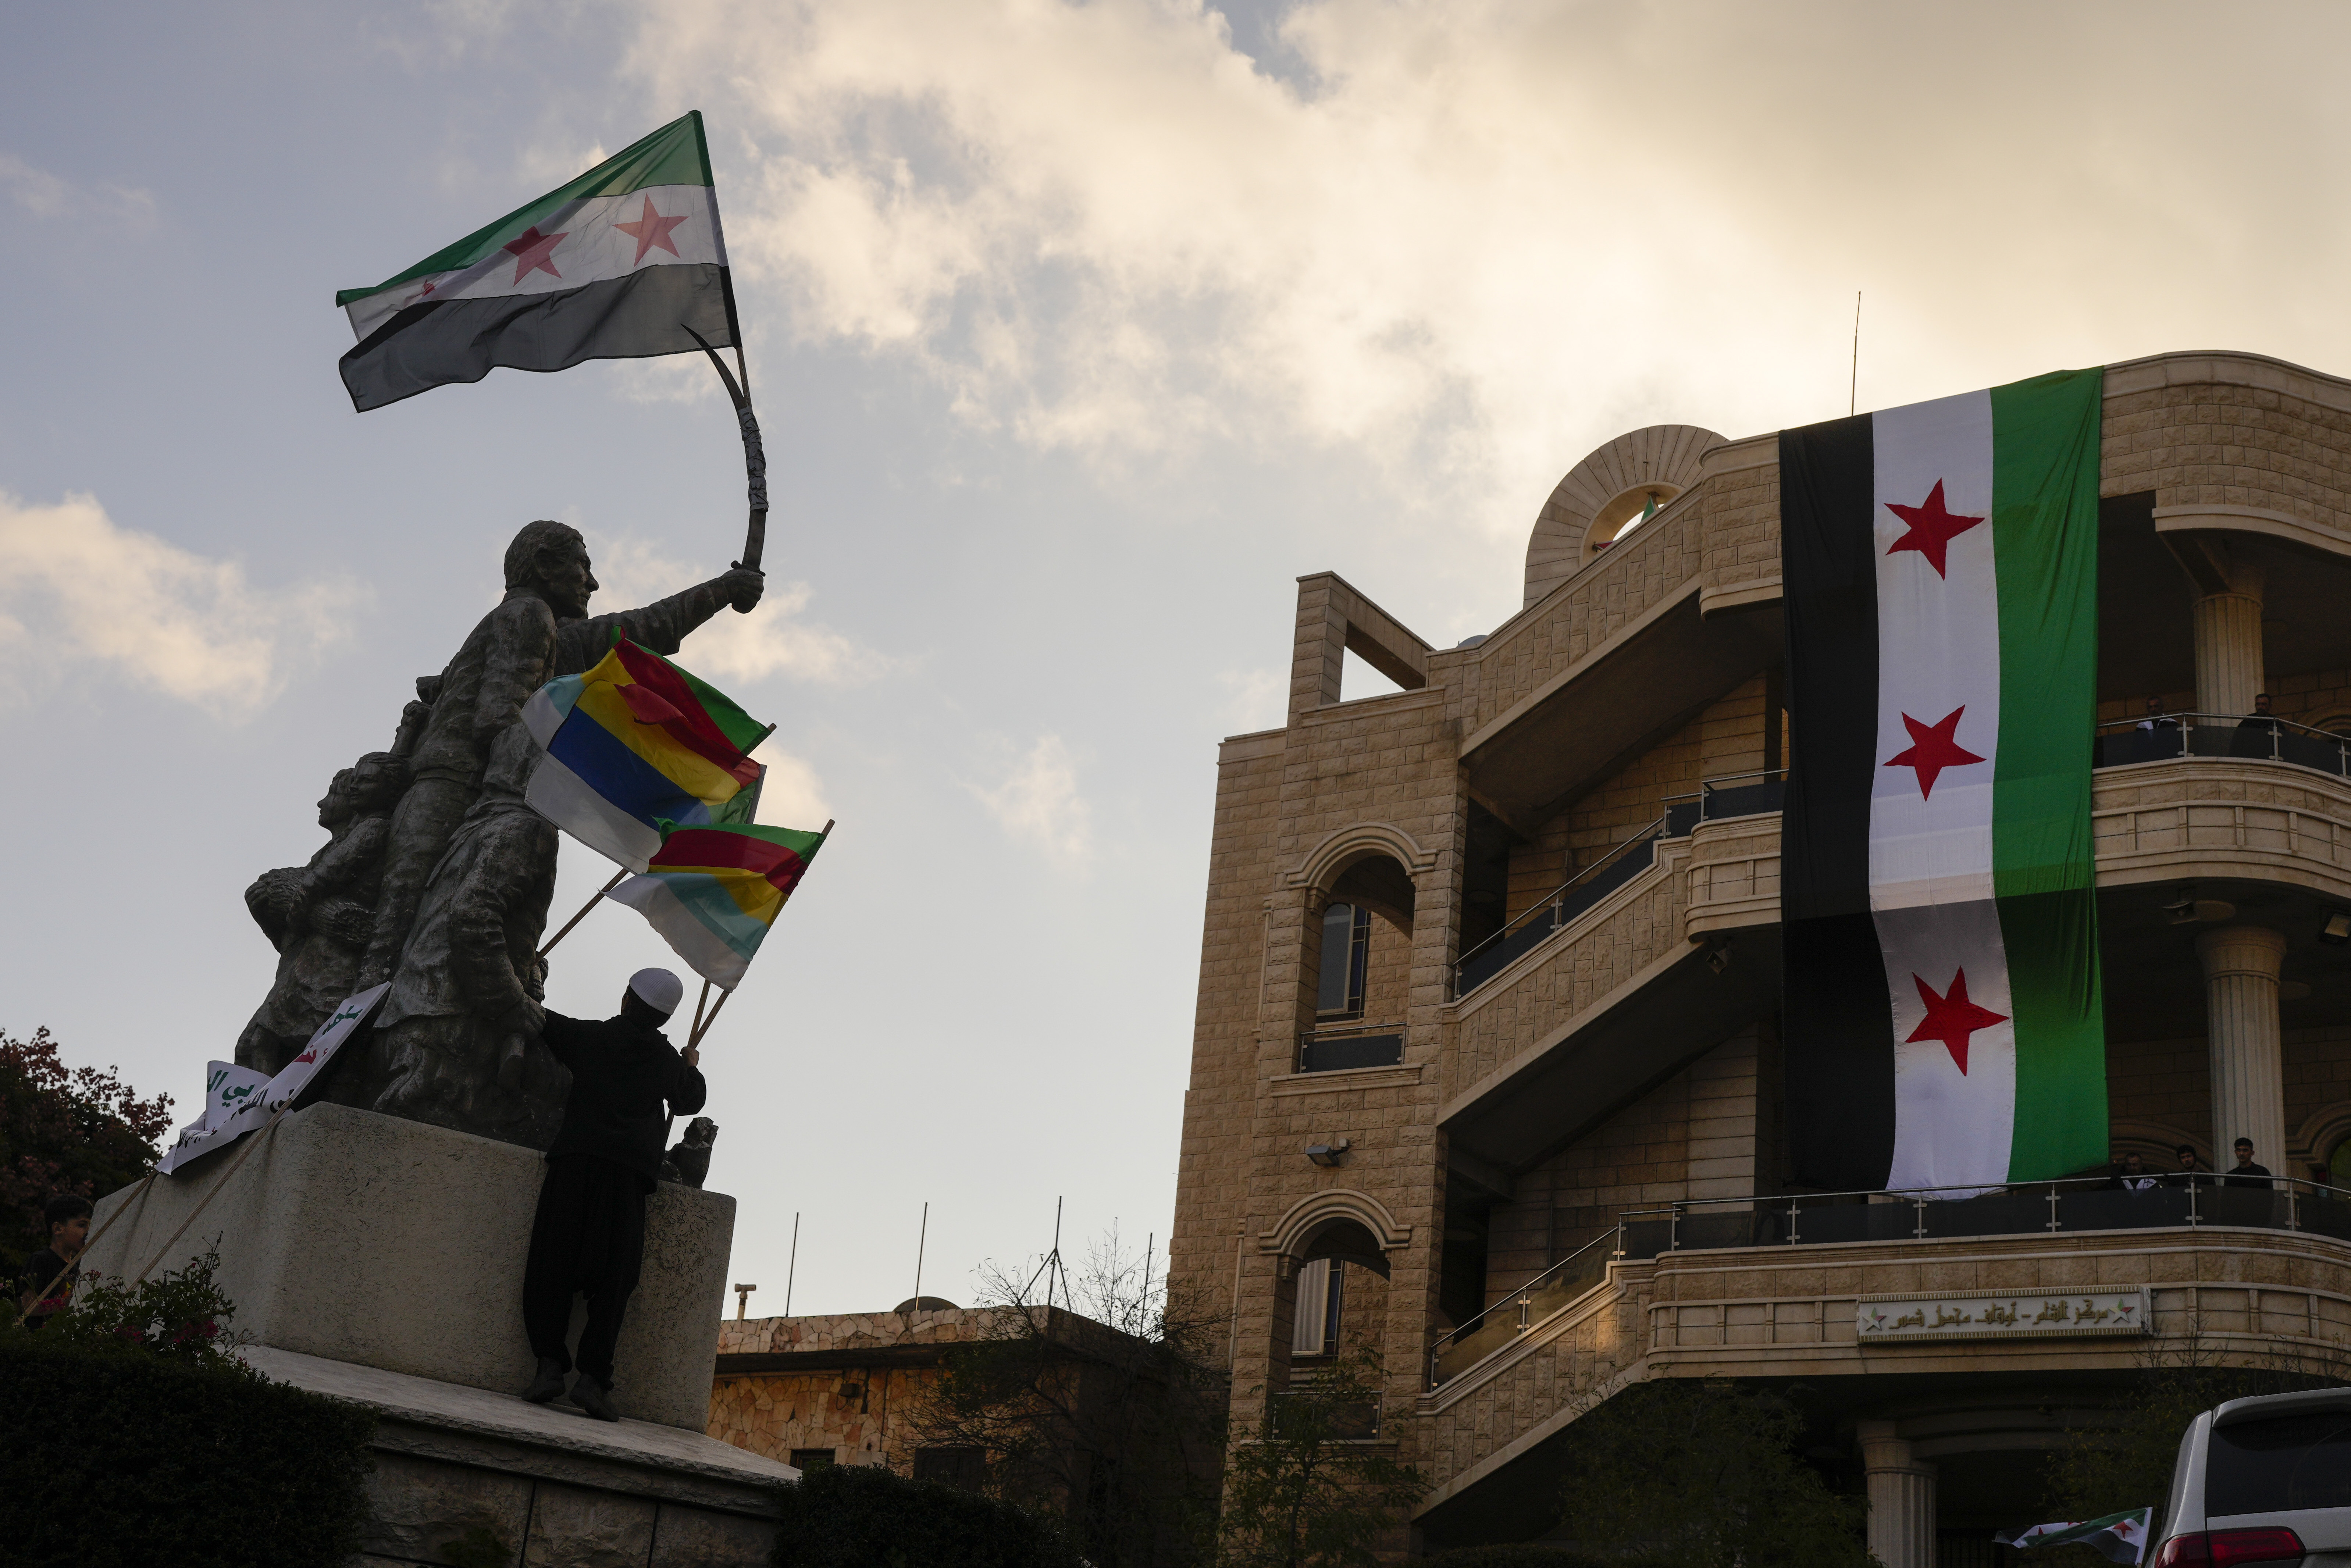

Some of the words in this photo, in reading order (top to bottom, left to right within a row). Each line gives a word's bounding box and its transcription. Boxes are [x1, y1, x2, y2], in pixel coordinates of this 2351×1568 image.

[1889, 1308, 1924, 1329] شمس
[1928, 1304, 1970, 1328] مجدل
[1975, 1301, 2018, 1326] أوقاف
[2033, 1300, 2070, 1325] الشام
[2074, 1299, 2108, 1325] مركز
